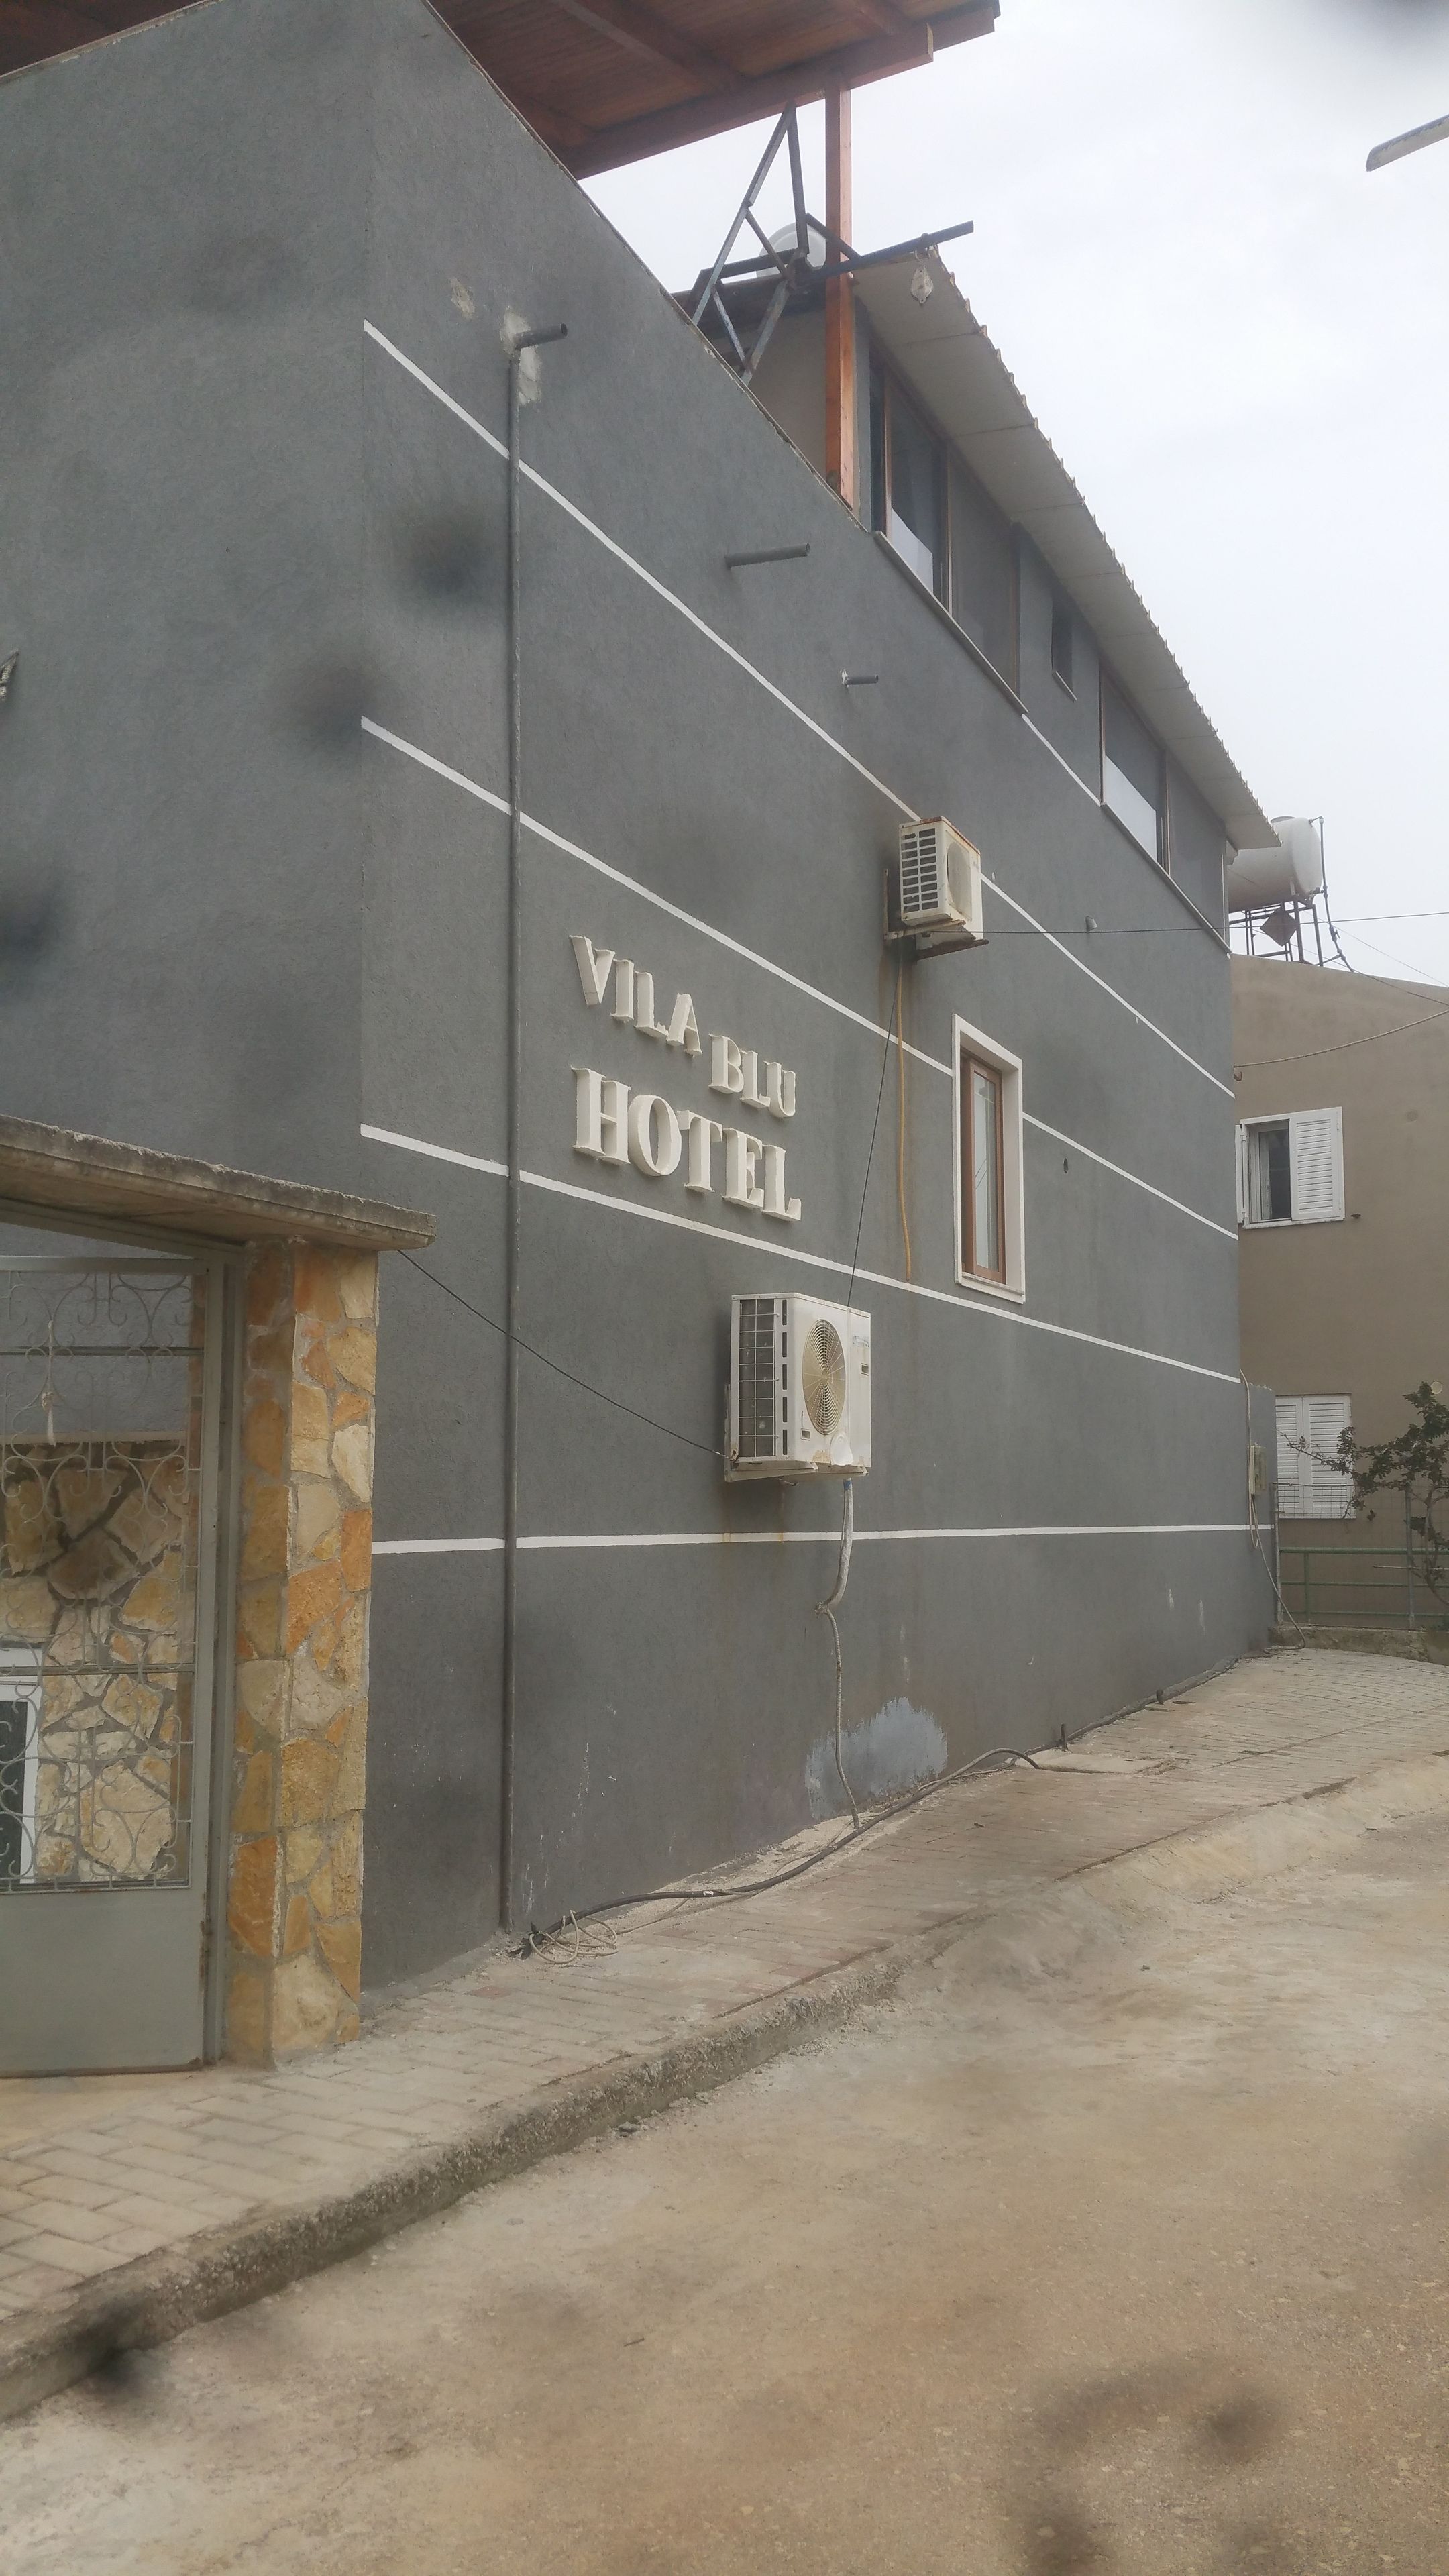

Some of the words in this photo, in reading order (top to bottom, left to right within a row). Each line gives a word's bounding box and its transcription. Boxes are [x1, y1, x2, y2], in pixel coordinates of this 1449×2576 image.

[569, 935, 702, 1056] VILA
[708, 1034, 796, 1118] BLU
[570, 1065, 802, 1221] HOTEL
